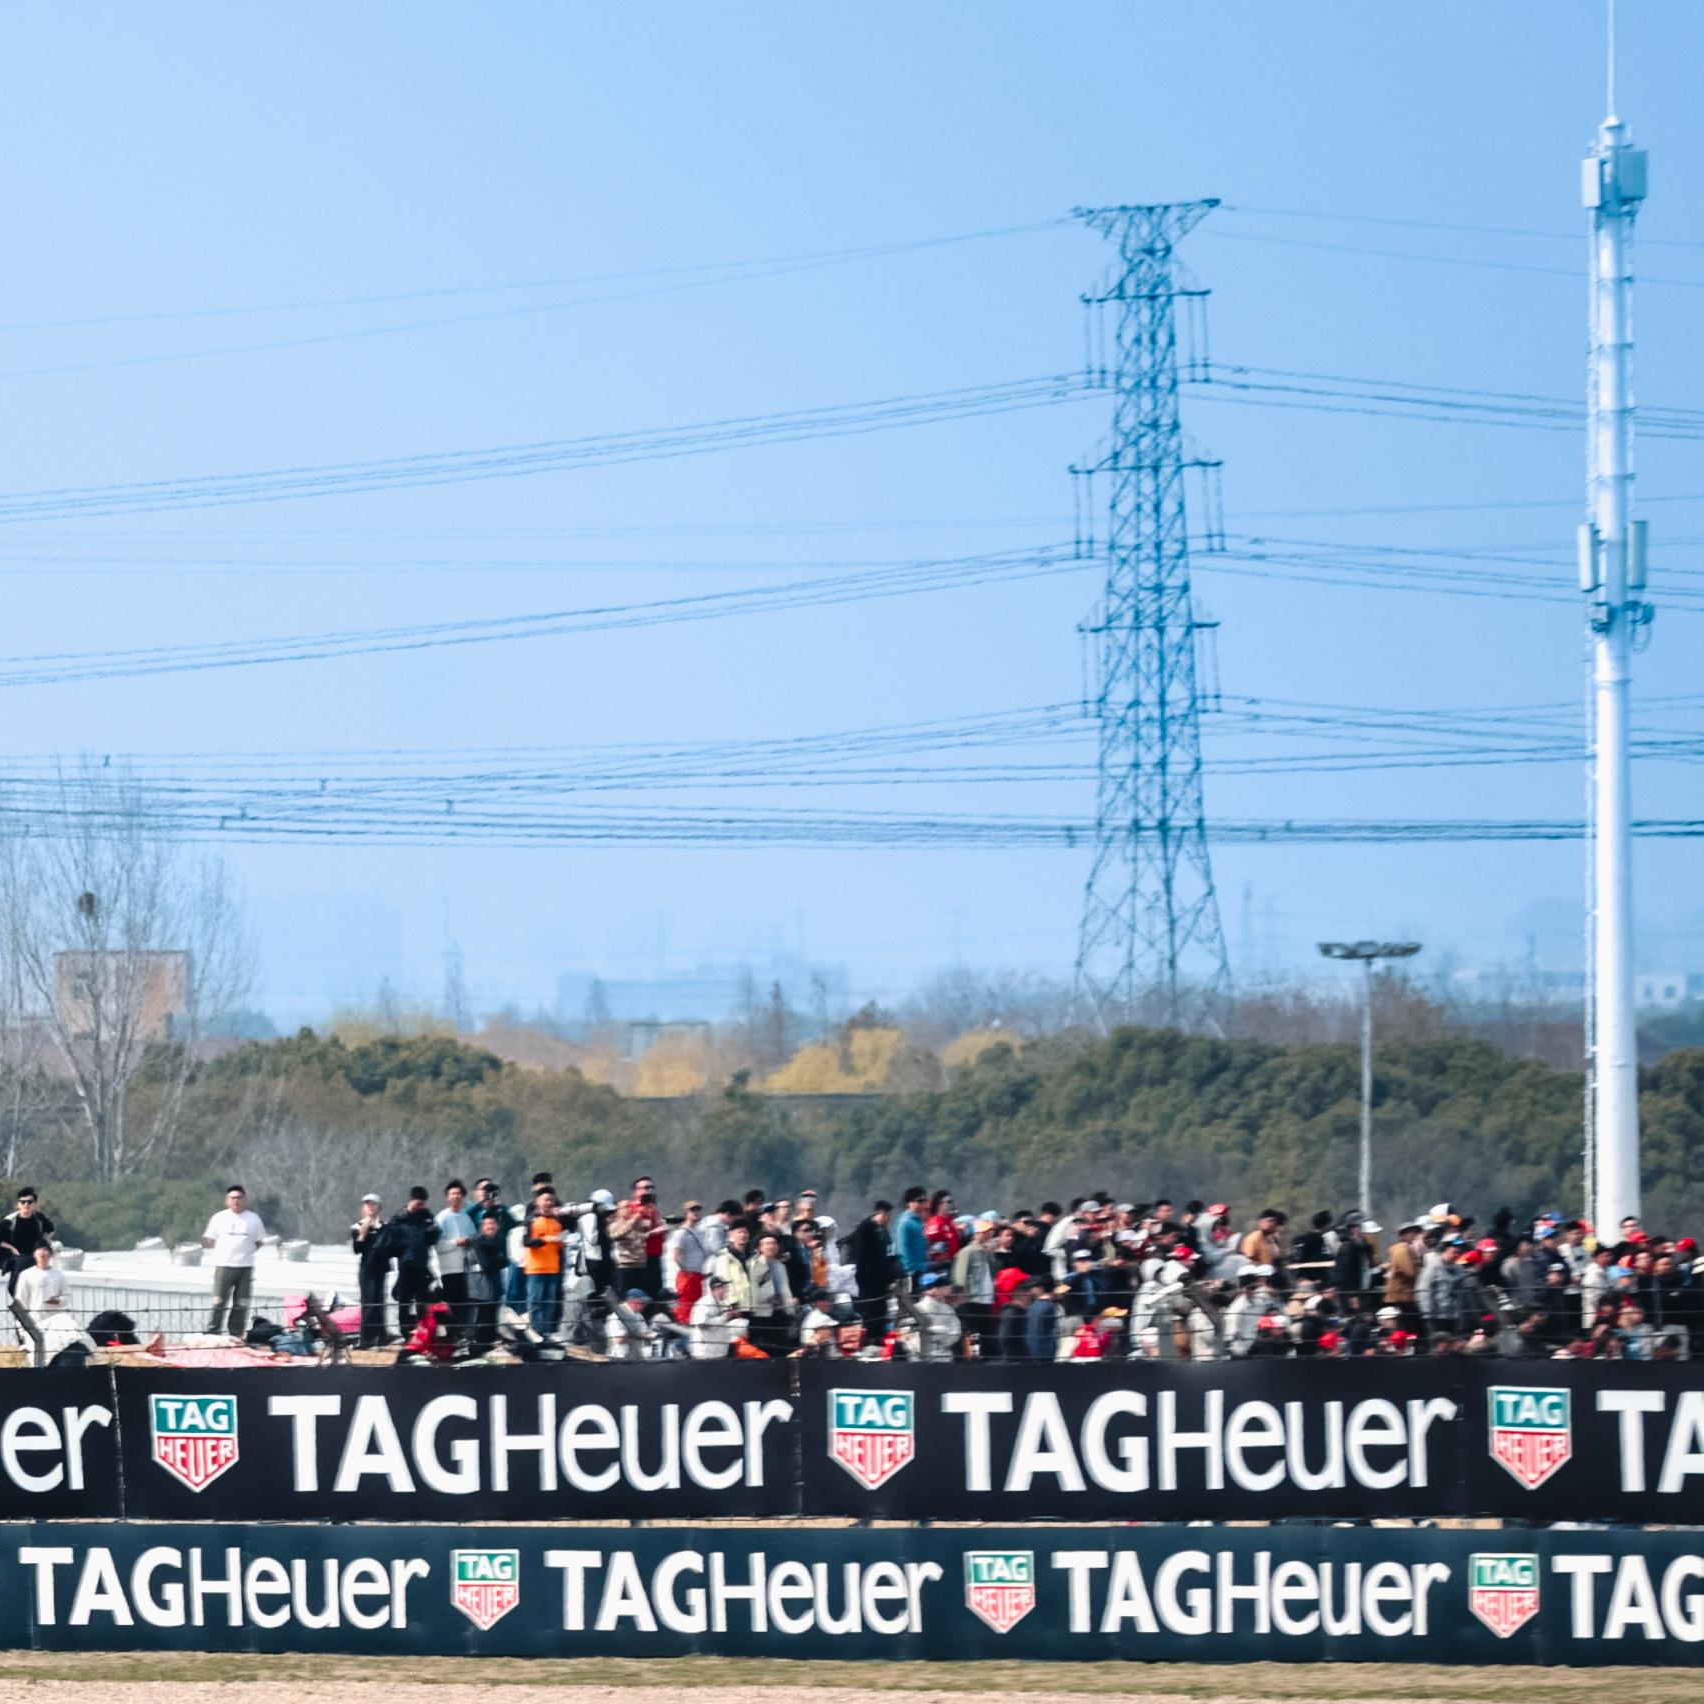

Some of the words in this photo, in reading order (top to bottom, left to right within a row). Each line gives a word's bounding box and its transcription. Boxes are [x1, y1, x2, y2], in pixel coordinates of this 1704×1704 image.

[159, 1401, 230, 1430] TAG
[837, 1396, 907, 1427] TAG
[1496, 1395, 1563, 1426] TAG
[158, 1439, 233, 1486] HEUER
[460, 1555, 515, 1581] TAG
[971, 1557, 1027, 1583] TAG
